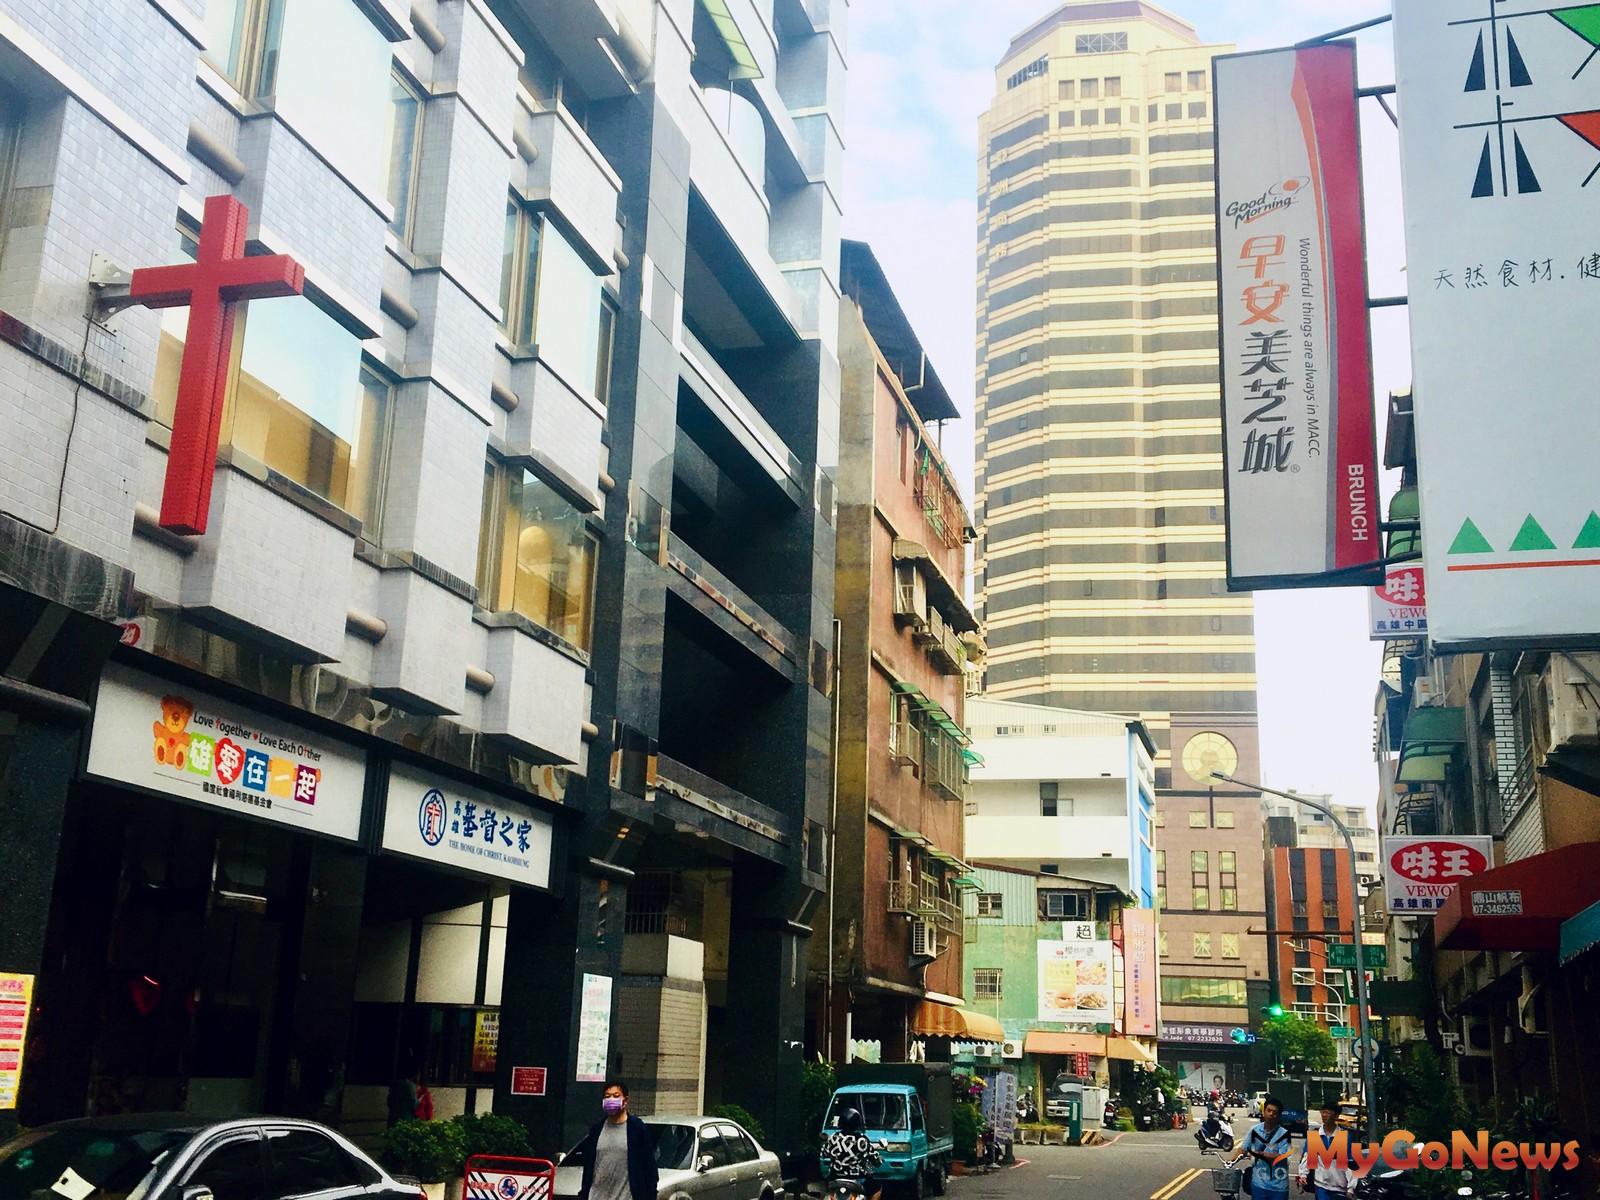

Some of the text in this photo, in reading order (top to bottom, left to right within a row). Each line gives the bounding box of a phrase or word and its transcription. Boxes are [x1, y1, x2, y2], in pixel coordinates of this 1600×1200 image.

[1226, 193, 1267, 217] Good
[1234, 196, 1292, 230] Morning
[1299, 237, 1314, 298] Wonderful
[1300, 302, 1315, 338] things
[1236, 234, 1295, 474] 早安美芝城
[1304, 340, 1314, 359] are
[1303, 360, 1317, 401] always
[1306, 404, 1319, 415] in
[1348, 463, 1368, 541] BRUNCH
[1384, 571, 1426, 602] 味
[193, 711, 214, 728] Love
[259, 732, 277, 748] Love
[278, 739, 296, 754] Each
[189, 738, 317, 801] 雄愛在一起
[462, 801, 532, 854] 基督之家
[448, 839, 459, 849] THE
[460, 842, 475, 855] HOME
[476, 846, 484, 856] OF
[1401, 845, 1474, 879] 味王
[1405, 885, 1457, 897] VEWO
[1076, 925, 1092, 939] 超
